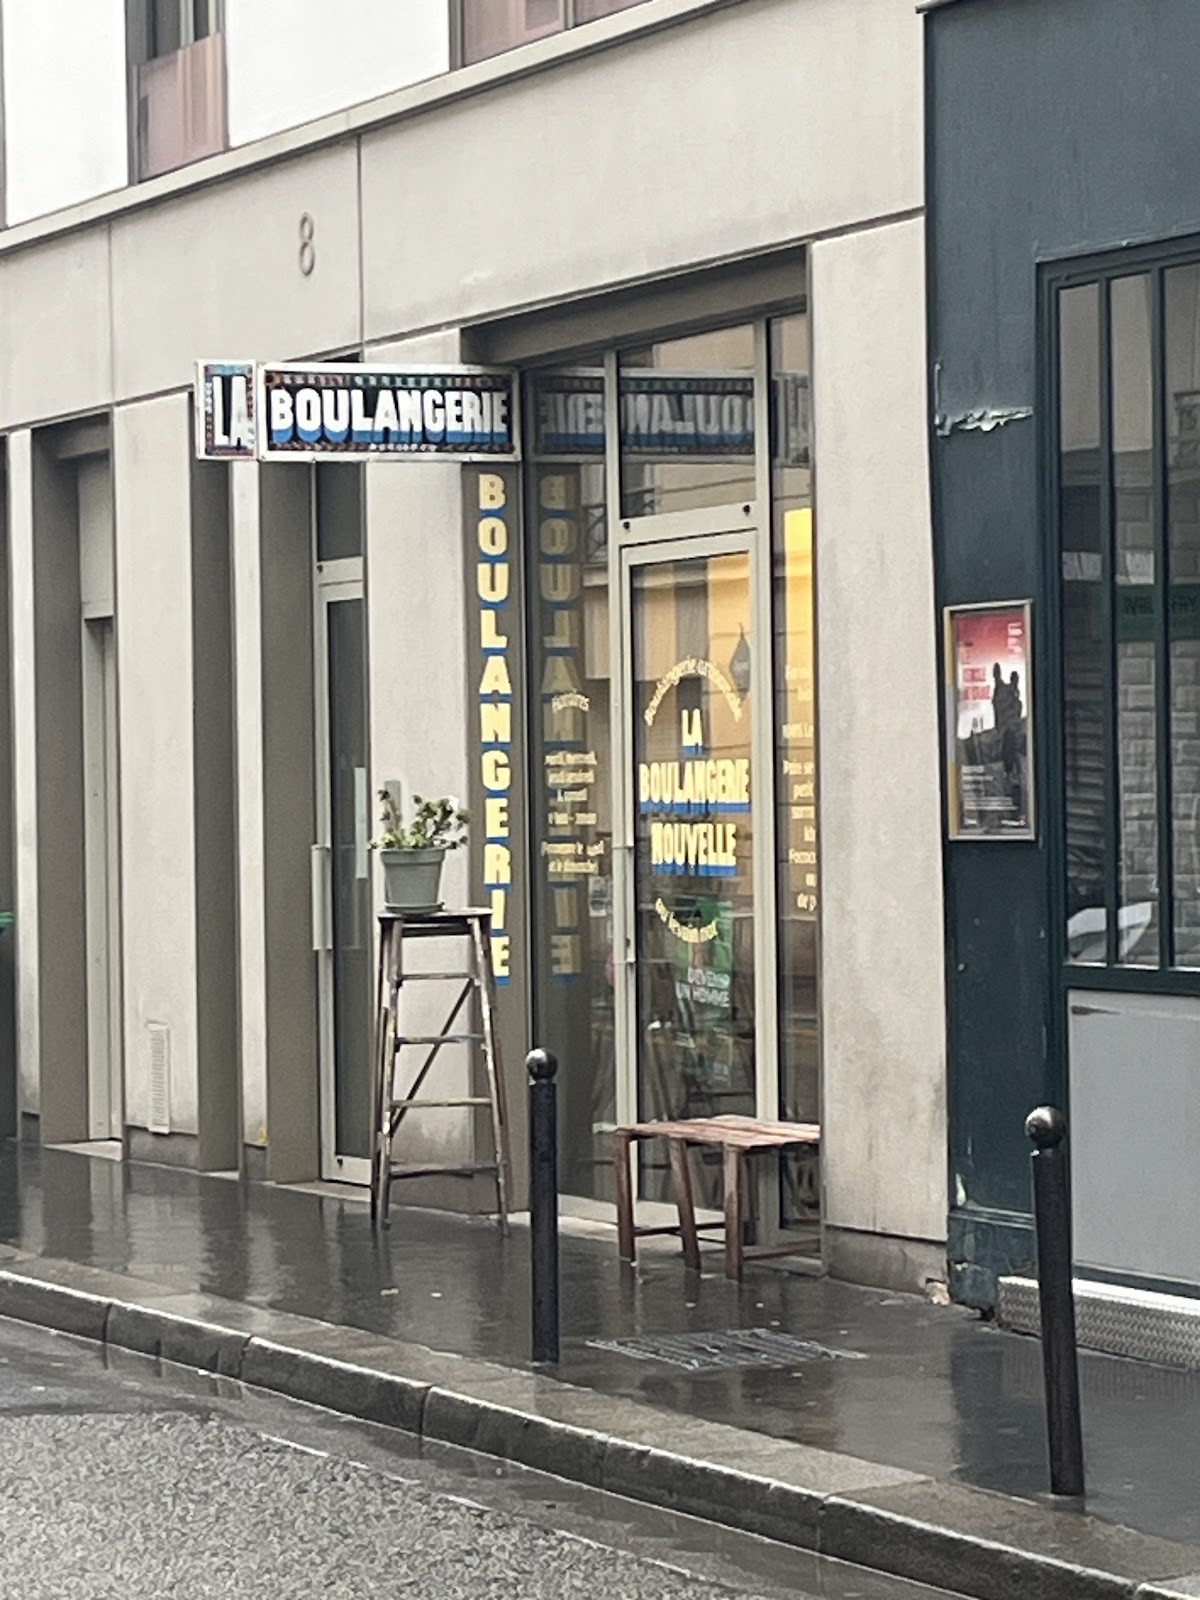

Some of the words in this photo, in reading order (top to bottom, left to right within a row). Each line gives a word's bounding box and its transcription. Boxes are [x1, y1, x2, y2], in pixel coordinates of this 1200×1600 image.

[299, 211, 316, 277] 8
[212, 375, 250, 446] LA
[270, 387, 508, 443] BOULANGERIE
[477, 473, 513, 984] BOULANGERIE
[681, 708, 703, 755] LA
[638, 758, 750, 813] BOULANGERIE
[650, 822, 737, 877] NOUVELLE
